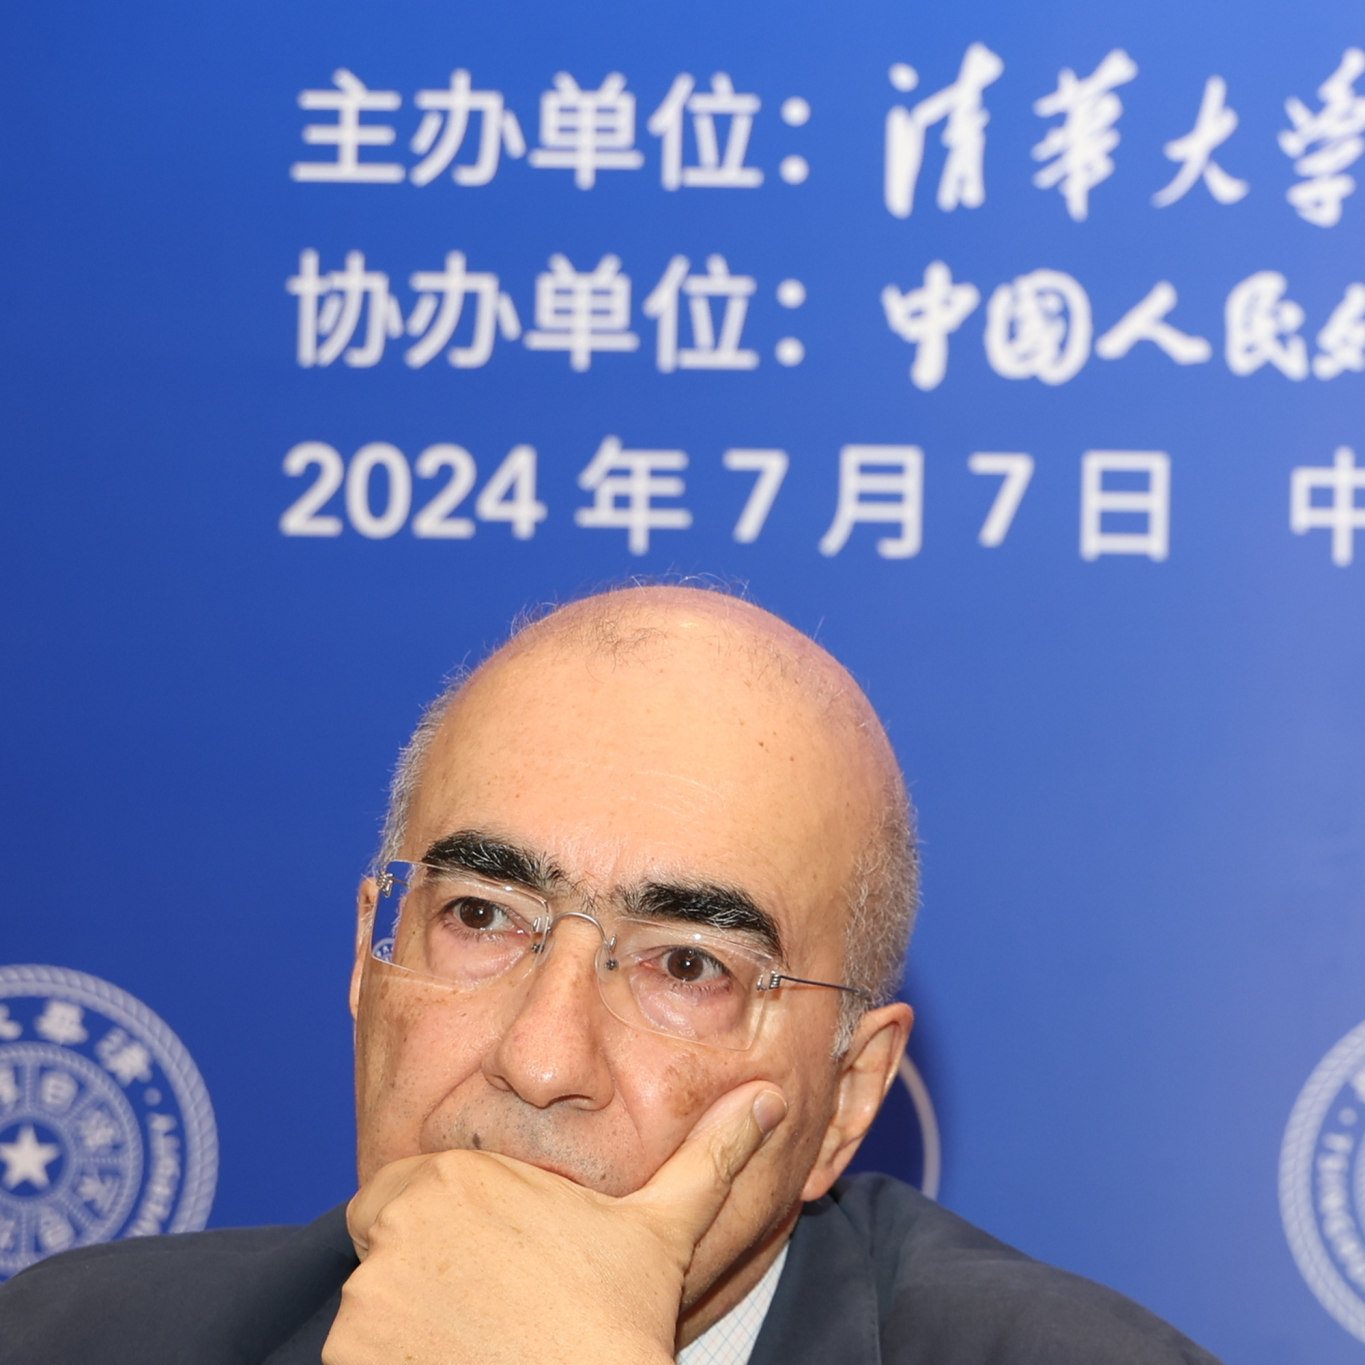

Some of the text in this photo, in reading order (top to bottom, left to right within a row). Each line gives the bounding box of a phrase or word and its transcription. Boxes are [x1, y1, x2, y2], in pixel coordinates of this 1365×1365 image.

[280, 442, 548, 540] 2024
[574, 436, 692, 555] 年
[723, 449, 790, 543] 7
[818, 445, 925, 559] 月
[969, 453, 1036, 547] 7
[1079, 450, 1172, 561] 日
